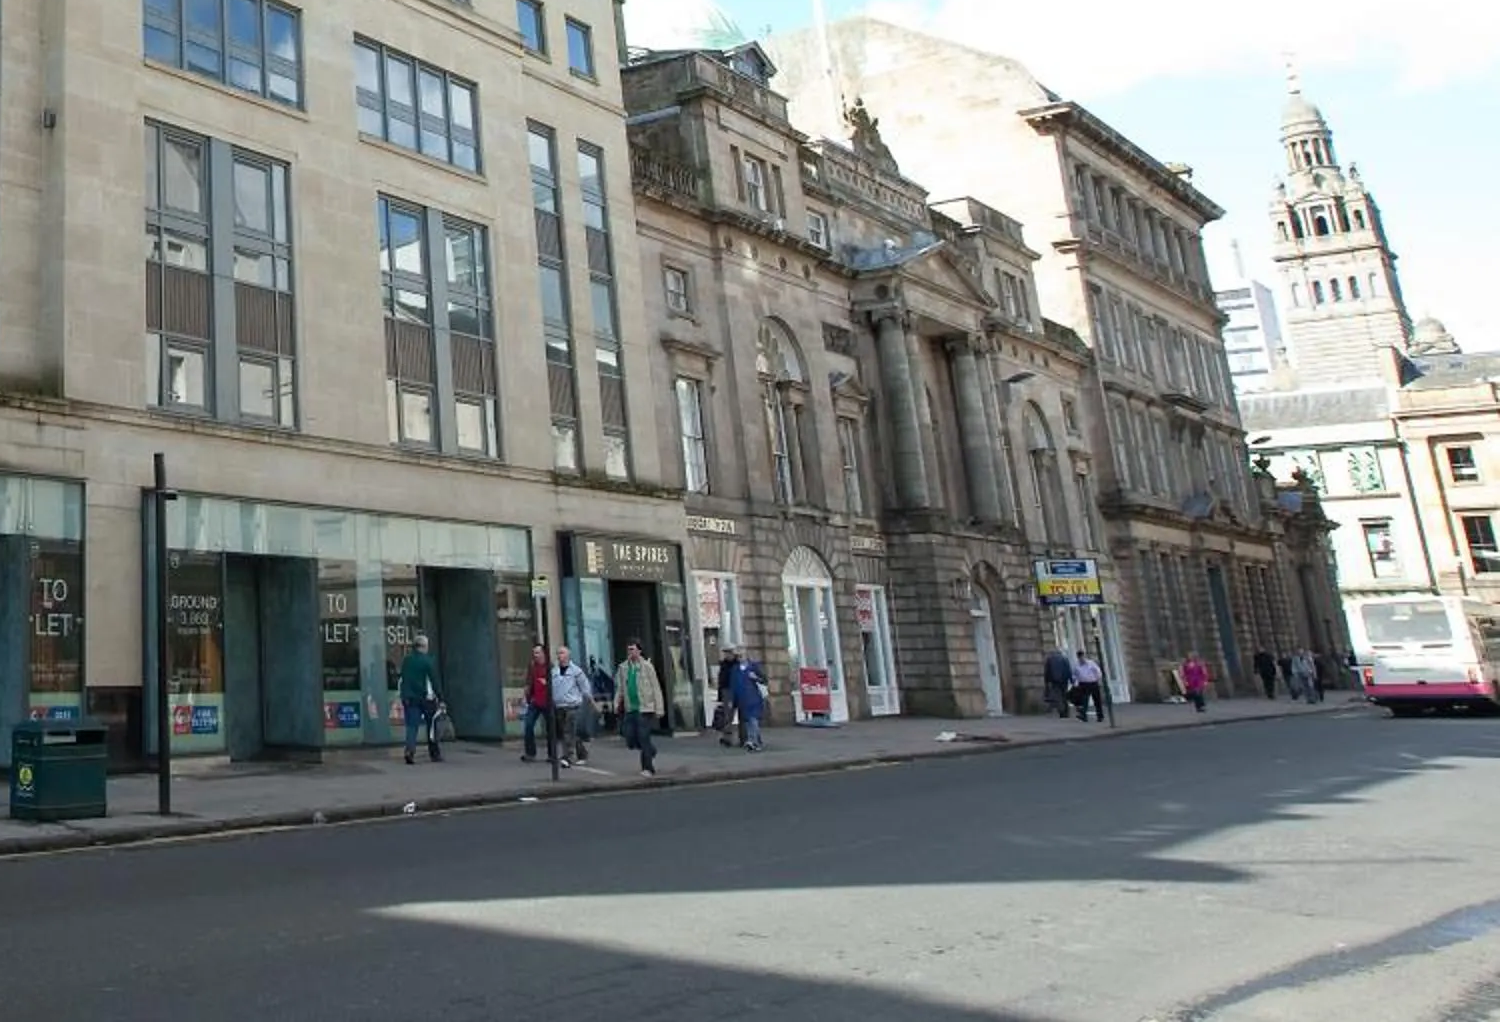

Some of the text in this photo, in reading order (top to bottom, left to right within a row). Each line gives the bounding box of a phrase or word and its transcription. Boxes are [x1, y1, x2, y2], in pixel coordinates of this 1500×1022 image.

[612, 543, 669, 564] THE SPIRES
[39, 578, 68, 602] TO
[171, 595, 217, 610] GROUND
[327, 593, 347, 613] TO
[387, 595, 418, 616] MAY
[35, 613, 73, 637] LET
[325, 623, 350, 643] LET
[387, 625, 415, 644] SEL
